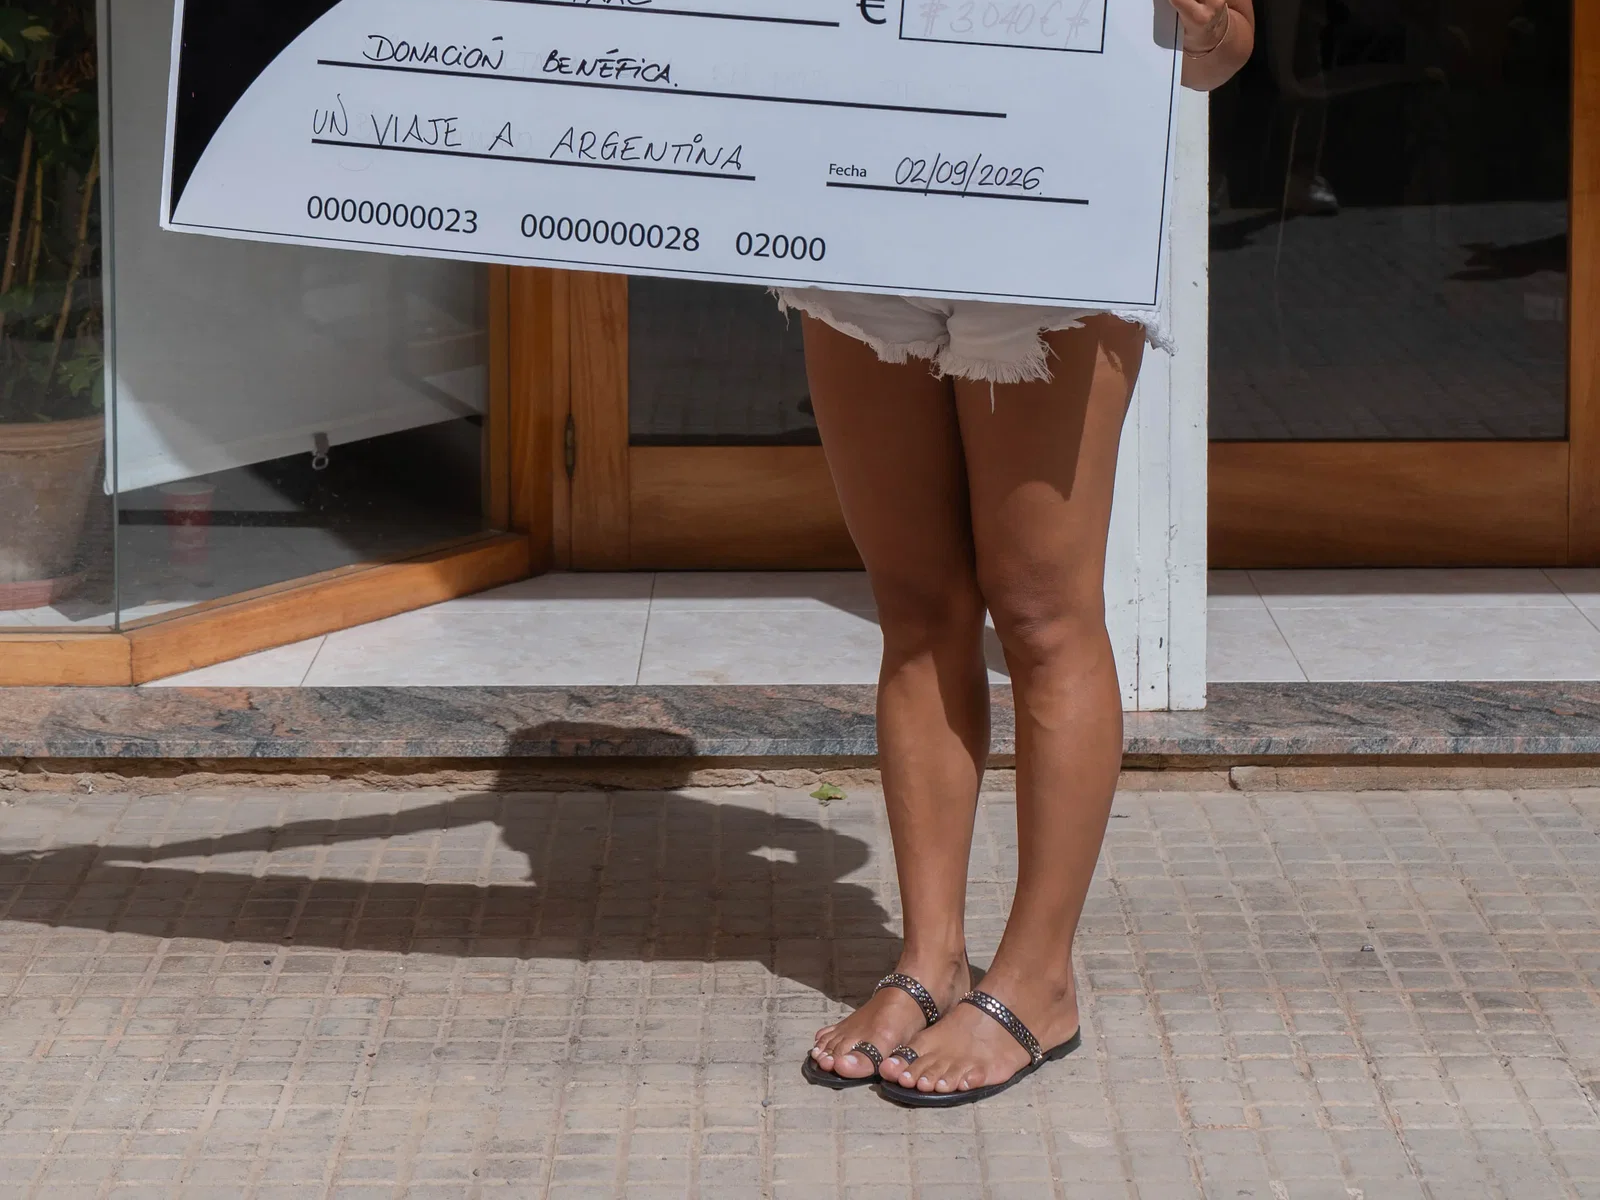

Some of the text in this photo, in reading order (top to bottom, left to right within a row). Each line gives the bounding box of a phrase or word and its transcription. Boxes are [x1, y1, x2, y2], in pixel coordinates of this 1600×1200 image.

[312, 93, 349, 138] UN
[370, 112, 463, 148] VIAJE
[488, 121, 515, 152] A
[828, 161, 868, 179] Fecha
[306, 194, 827, 262] 0000000023 0000000028 02000
